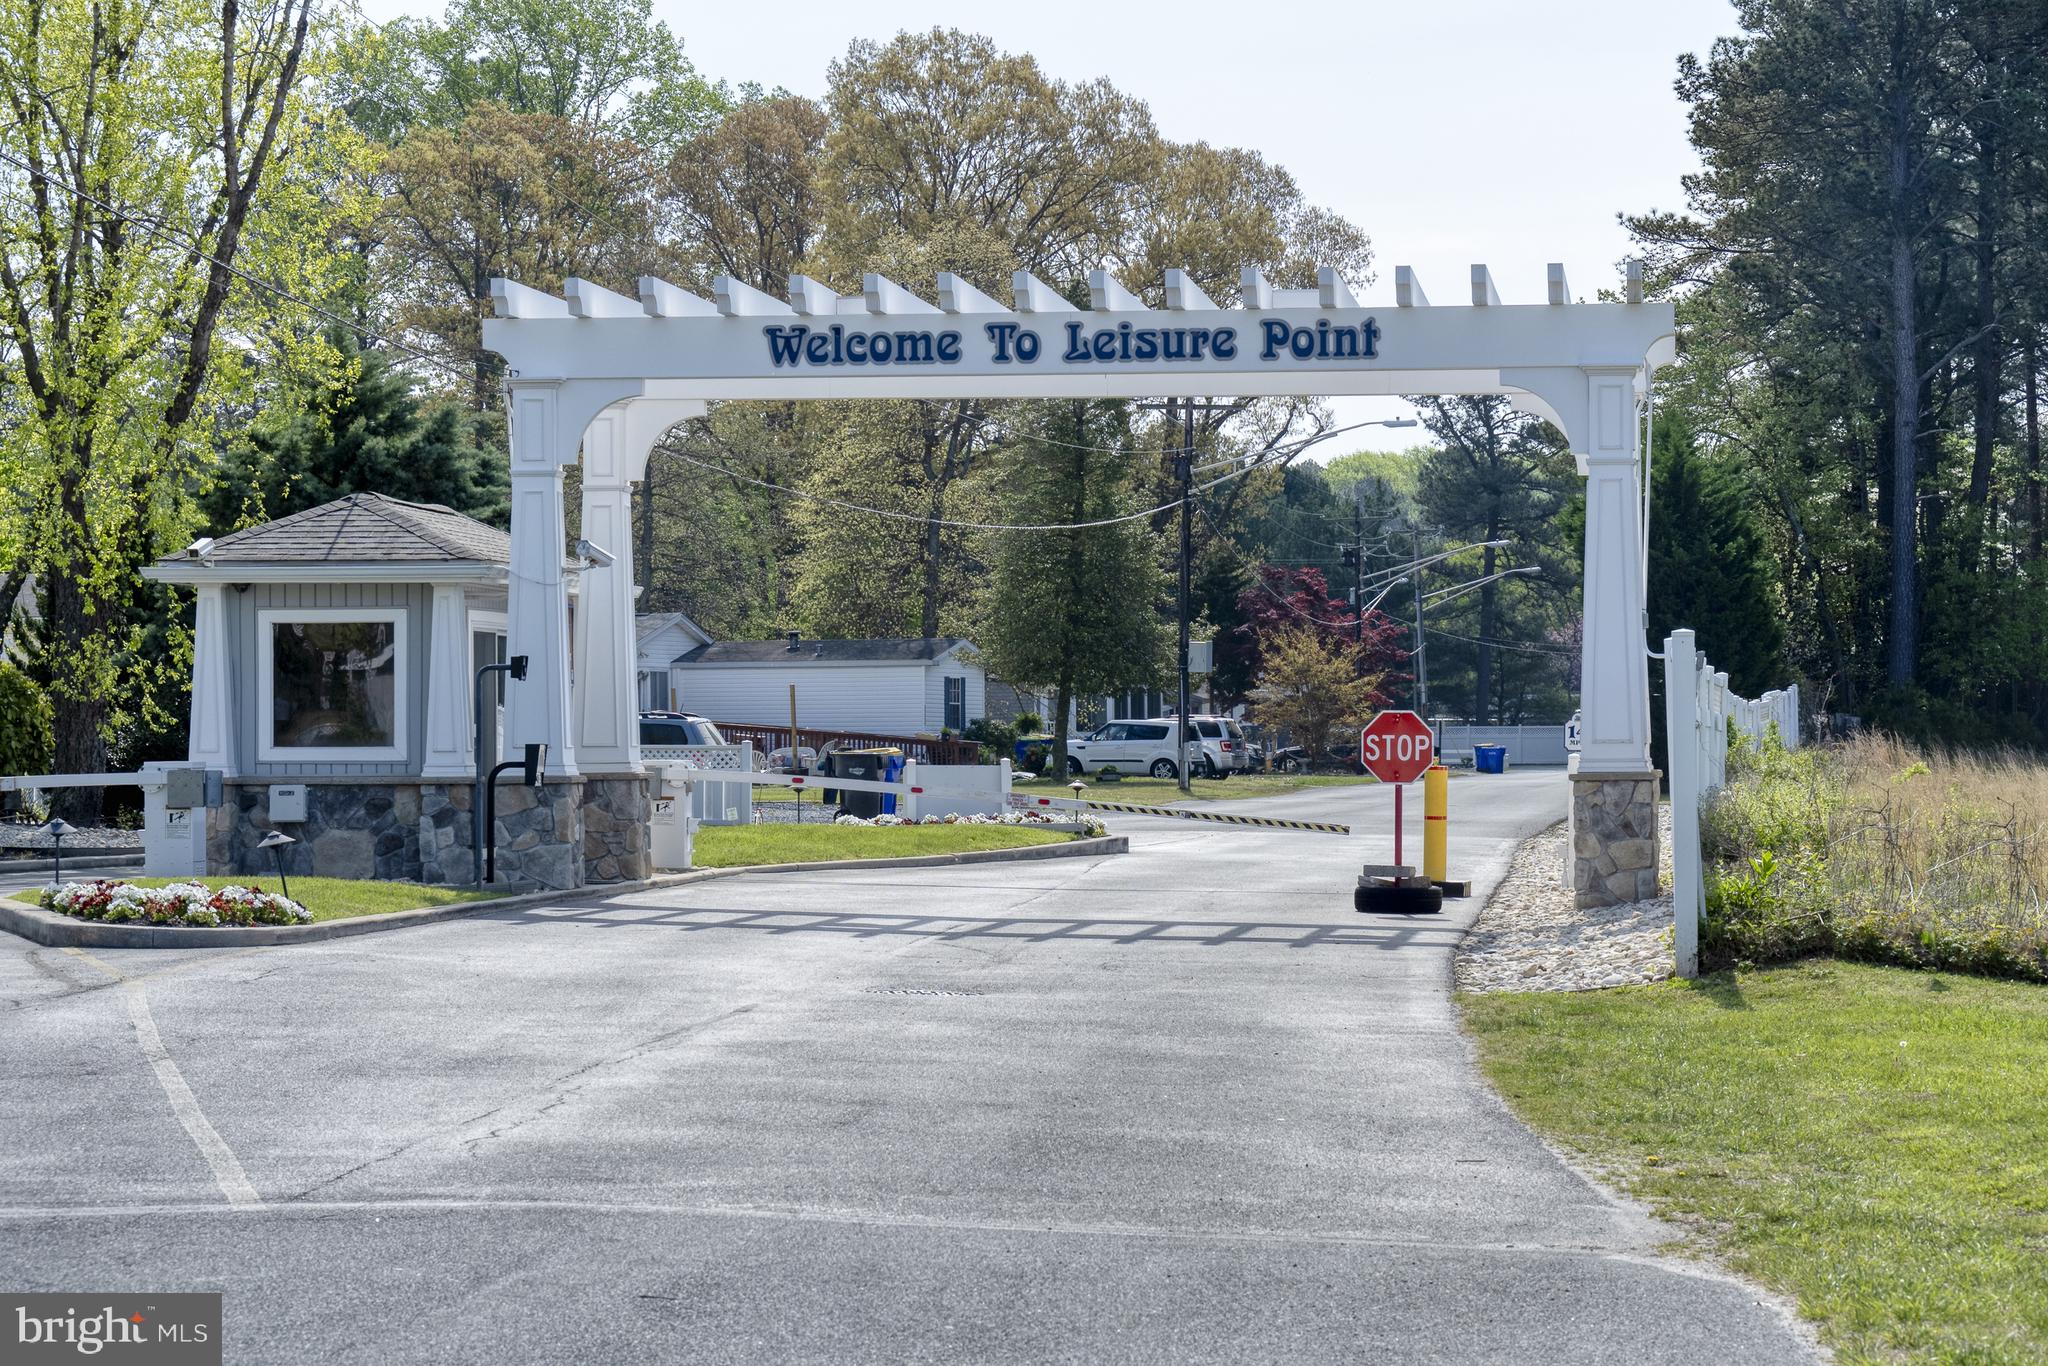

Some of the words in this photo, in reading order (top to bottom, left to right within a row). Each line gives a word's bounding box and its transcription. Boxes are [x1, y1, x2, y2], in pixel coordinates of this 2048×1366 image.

[764, 325, 961, 366] Welcome
[985, 323, 1040, 363] To
[1064, 322, 1237, 361] Leisure
[1260, 318, 1380, 360] Point
[1365, 734, 1430, 761] STOP
